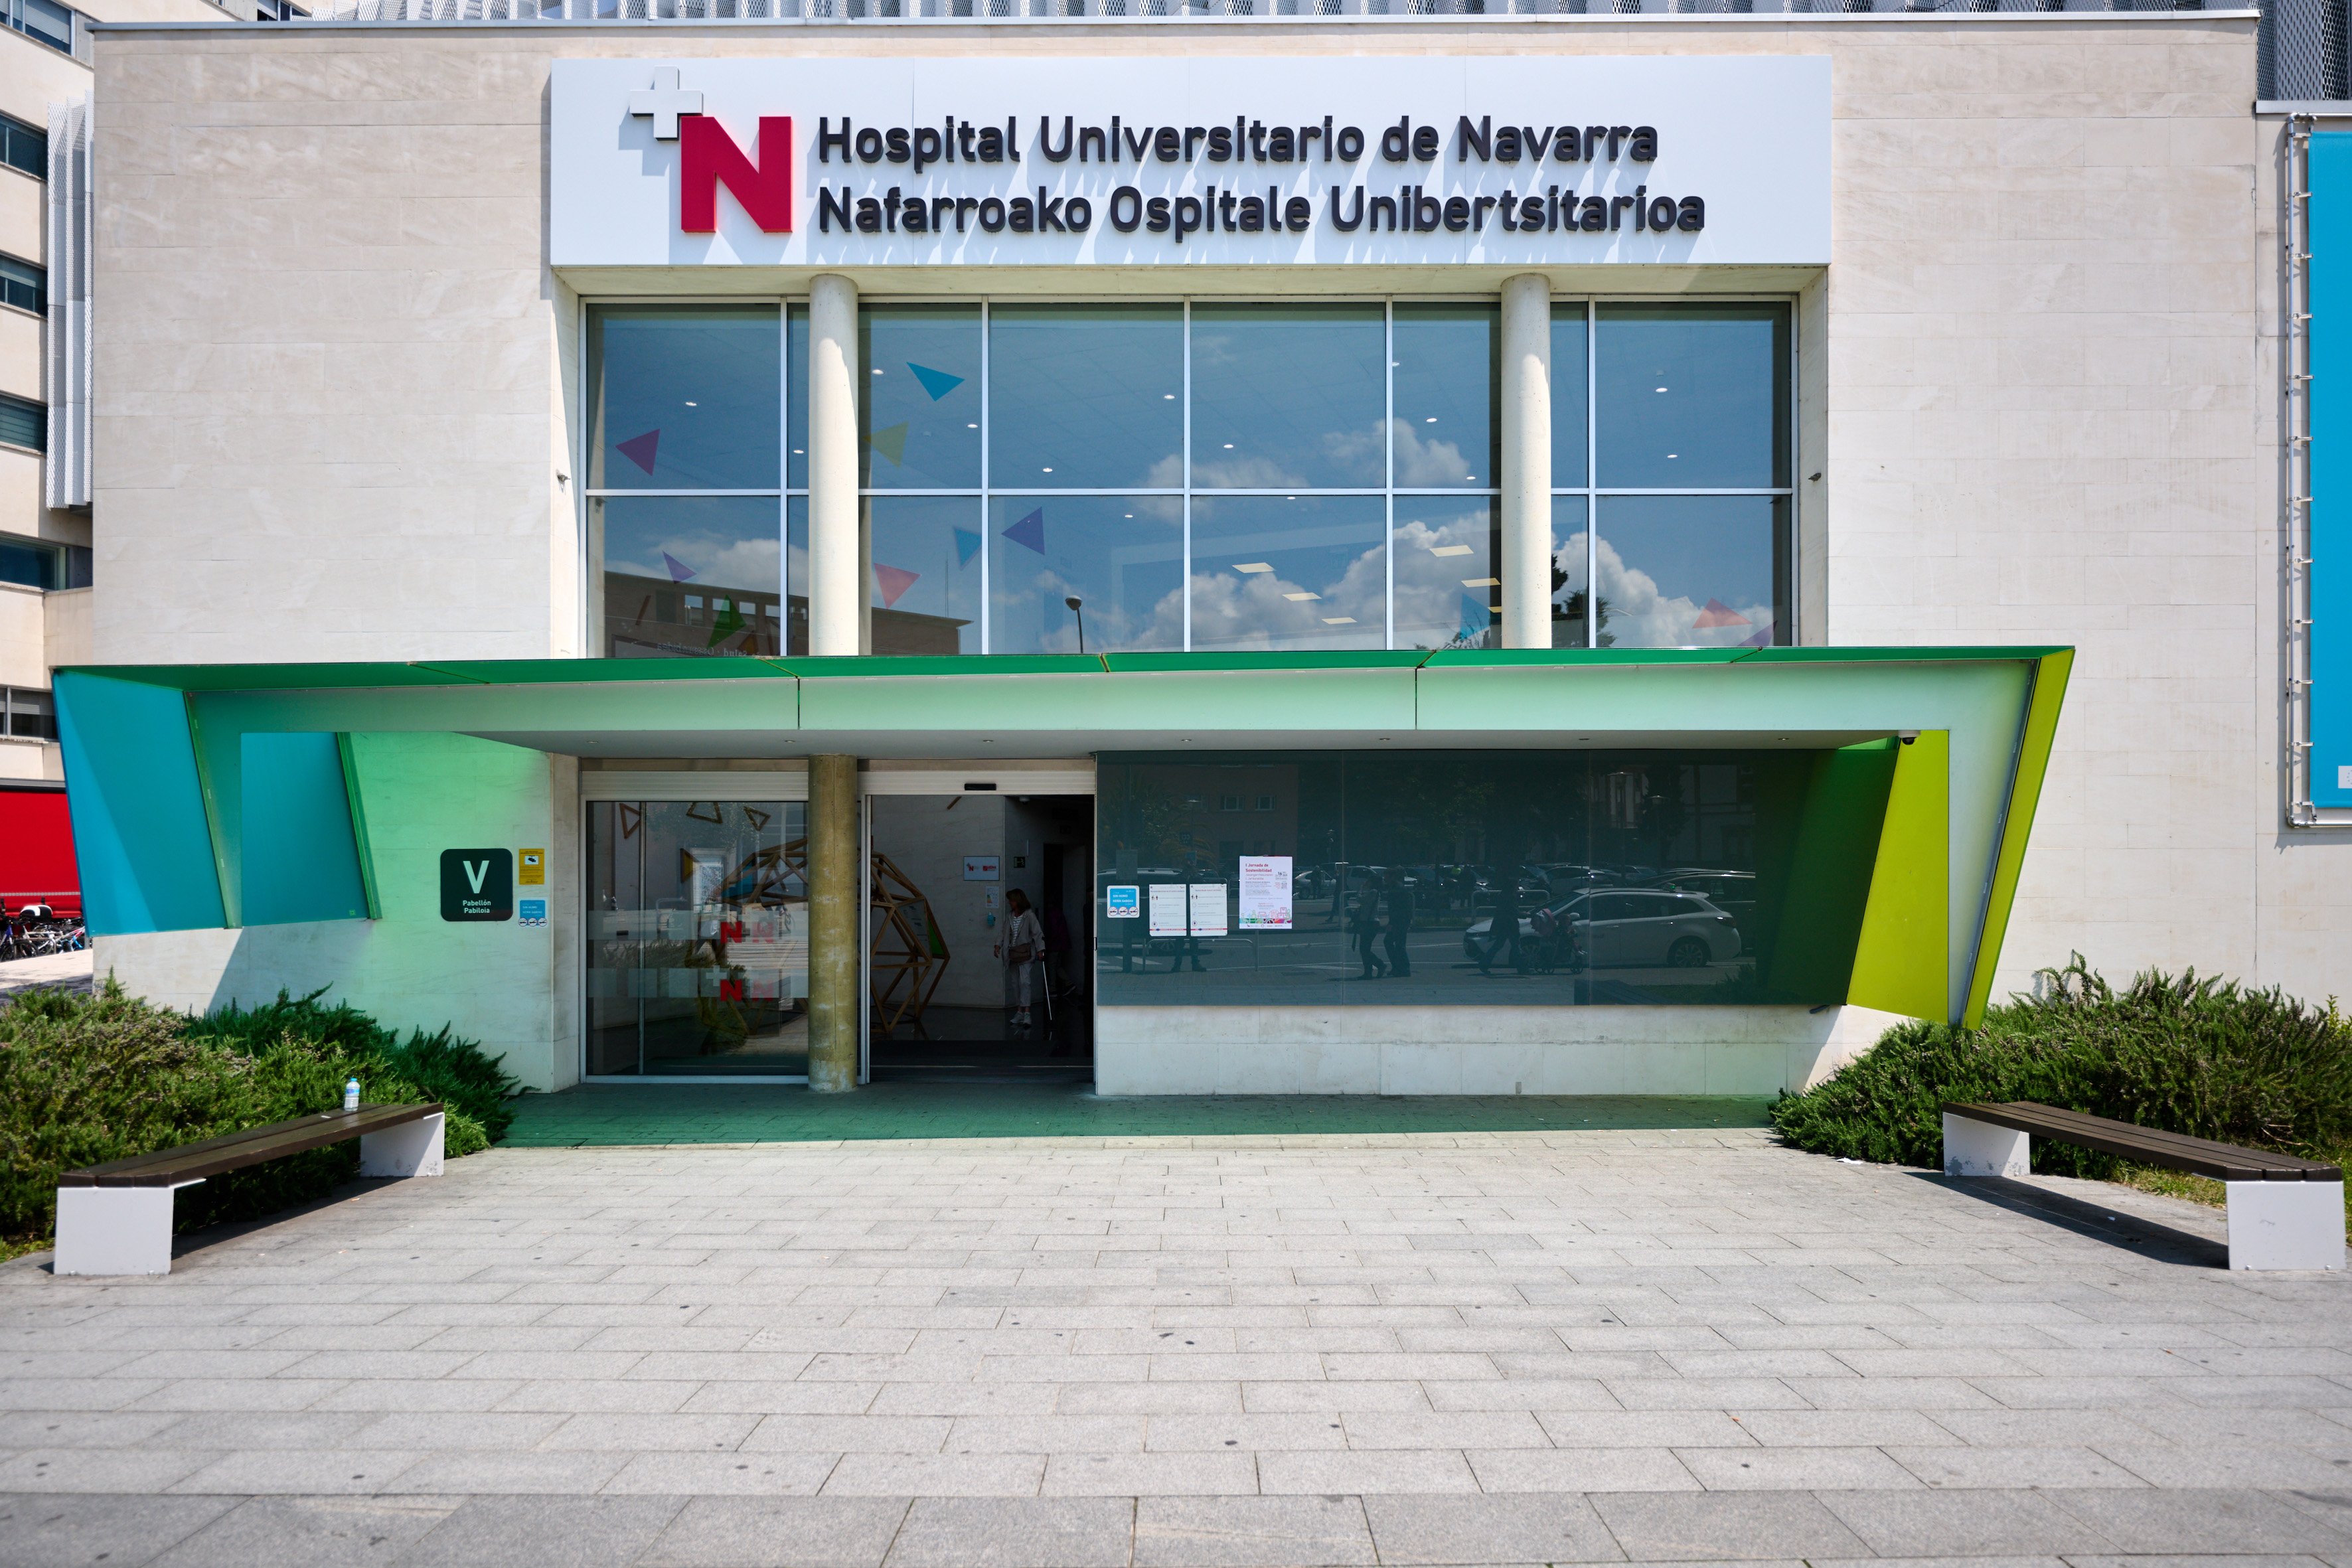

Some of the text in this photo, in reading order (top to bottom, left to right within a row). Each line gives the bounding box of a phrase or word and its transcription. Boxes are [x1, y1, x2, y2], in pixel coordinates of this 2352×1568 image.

[819, 116, 1658, 173] Hospital Universitario de Navarra
[681, 116, 792, 233] N
[819, 185, 1705, 244] Nafarroako Ospitale Unibertsitarioa
[463, 860, 490, 894] V
